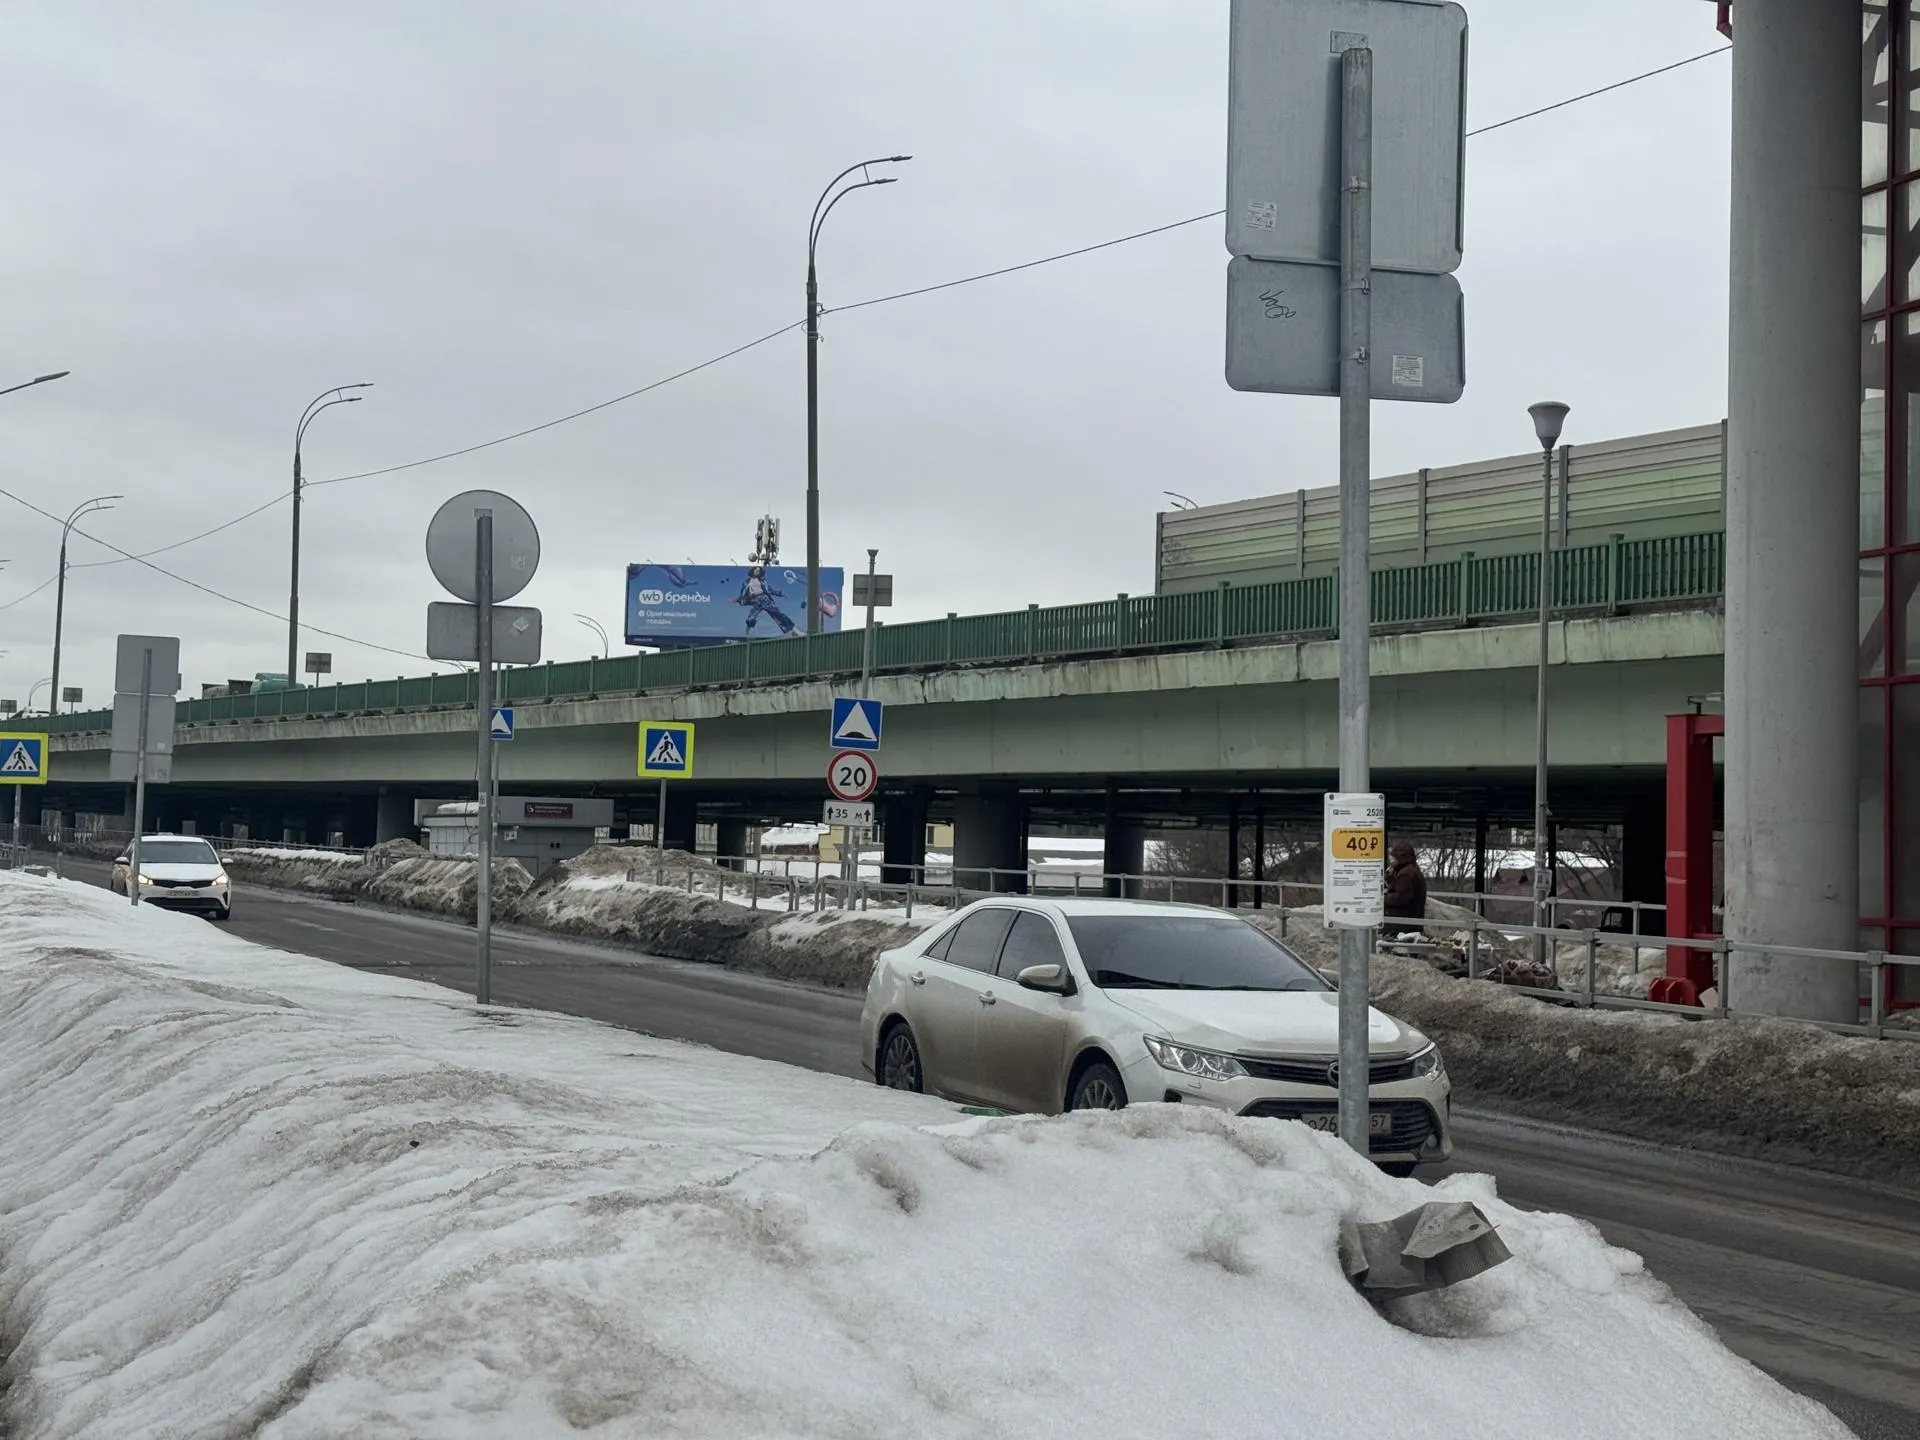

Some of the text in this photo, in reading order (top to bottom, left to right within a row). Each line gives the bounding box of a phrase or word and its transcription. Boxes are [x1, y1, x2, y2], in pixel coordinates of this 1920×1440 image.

[665, 591, 711, 604] бренды
[839, 766, 867, 787] 20
[835, 808, 848, 818] 35
